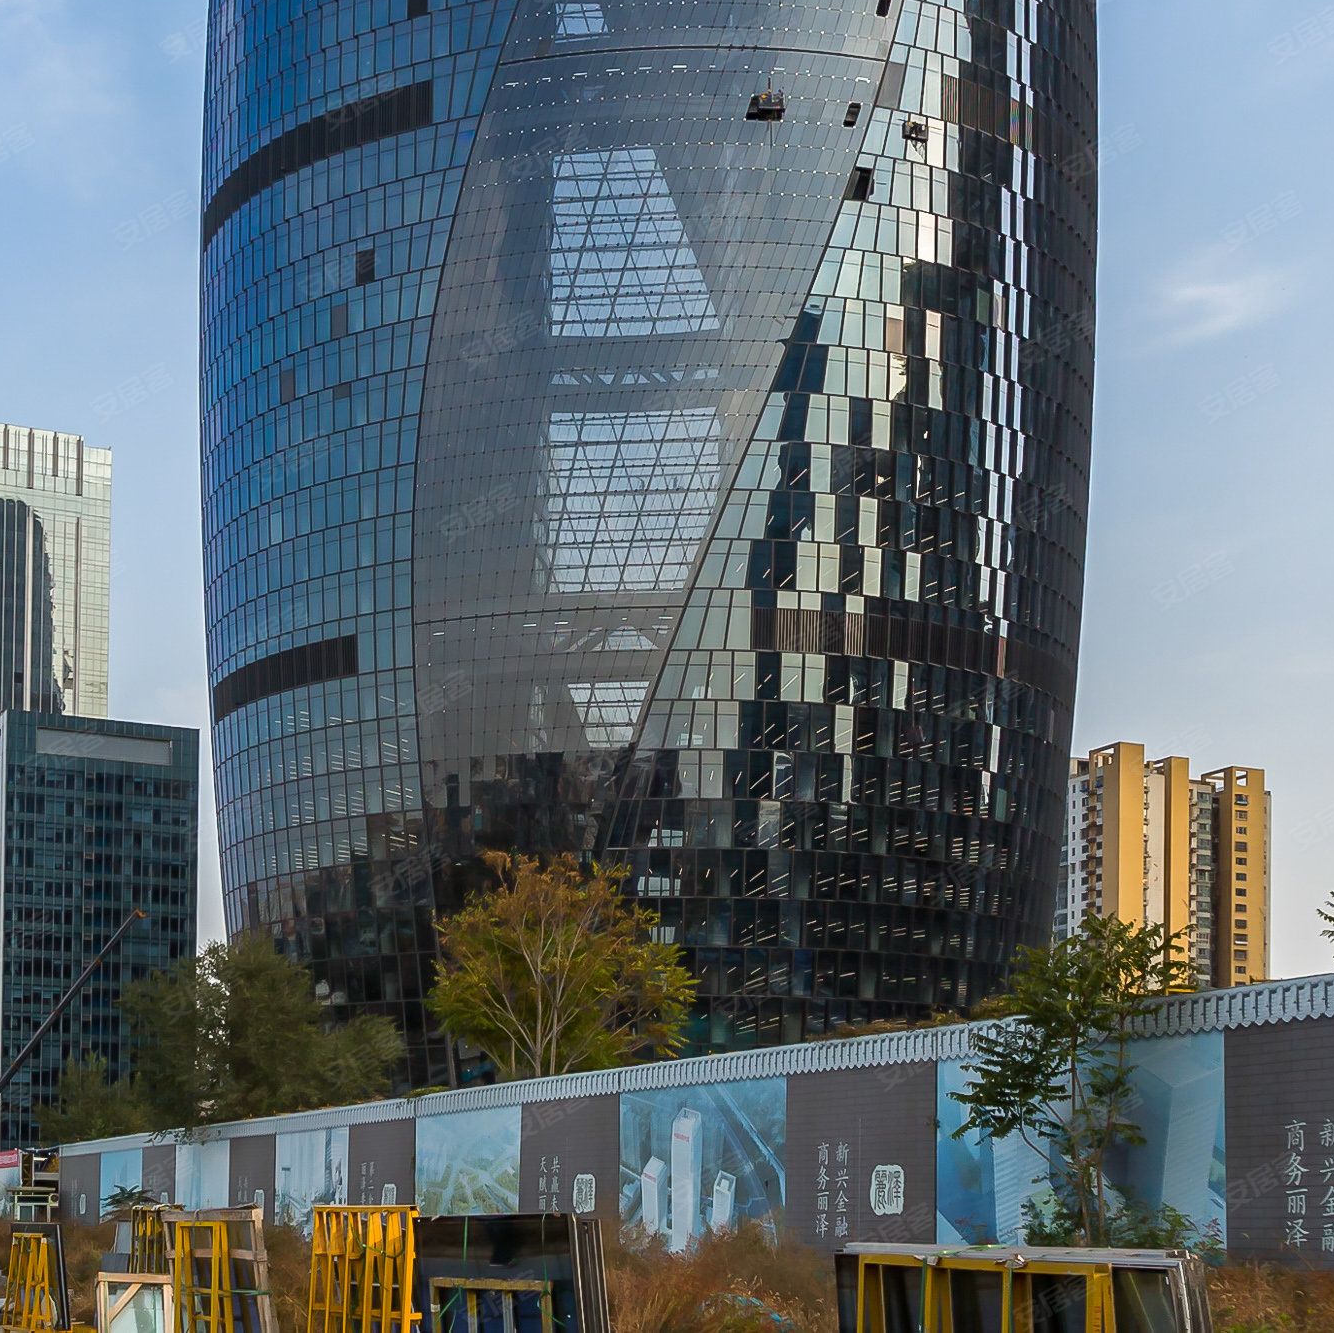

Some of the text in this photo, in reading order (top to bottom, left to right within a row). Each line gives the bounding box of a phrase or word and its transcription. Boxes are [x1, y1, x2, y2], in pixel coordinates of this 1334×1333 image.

[816, 1142, 830, 1239] 商务丽泽
[834, 1142, 849, 1238] 新兴金融
[1284, 1119, 1310, 1248] 商务丽泽
